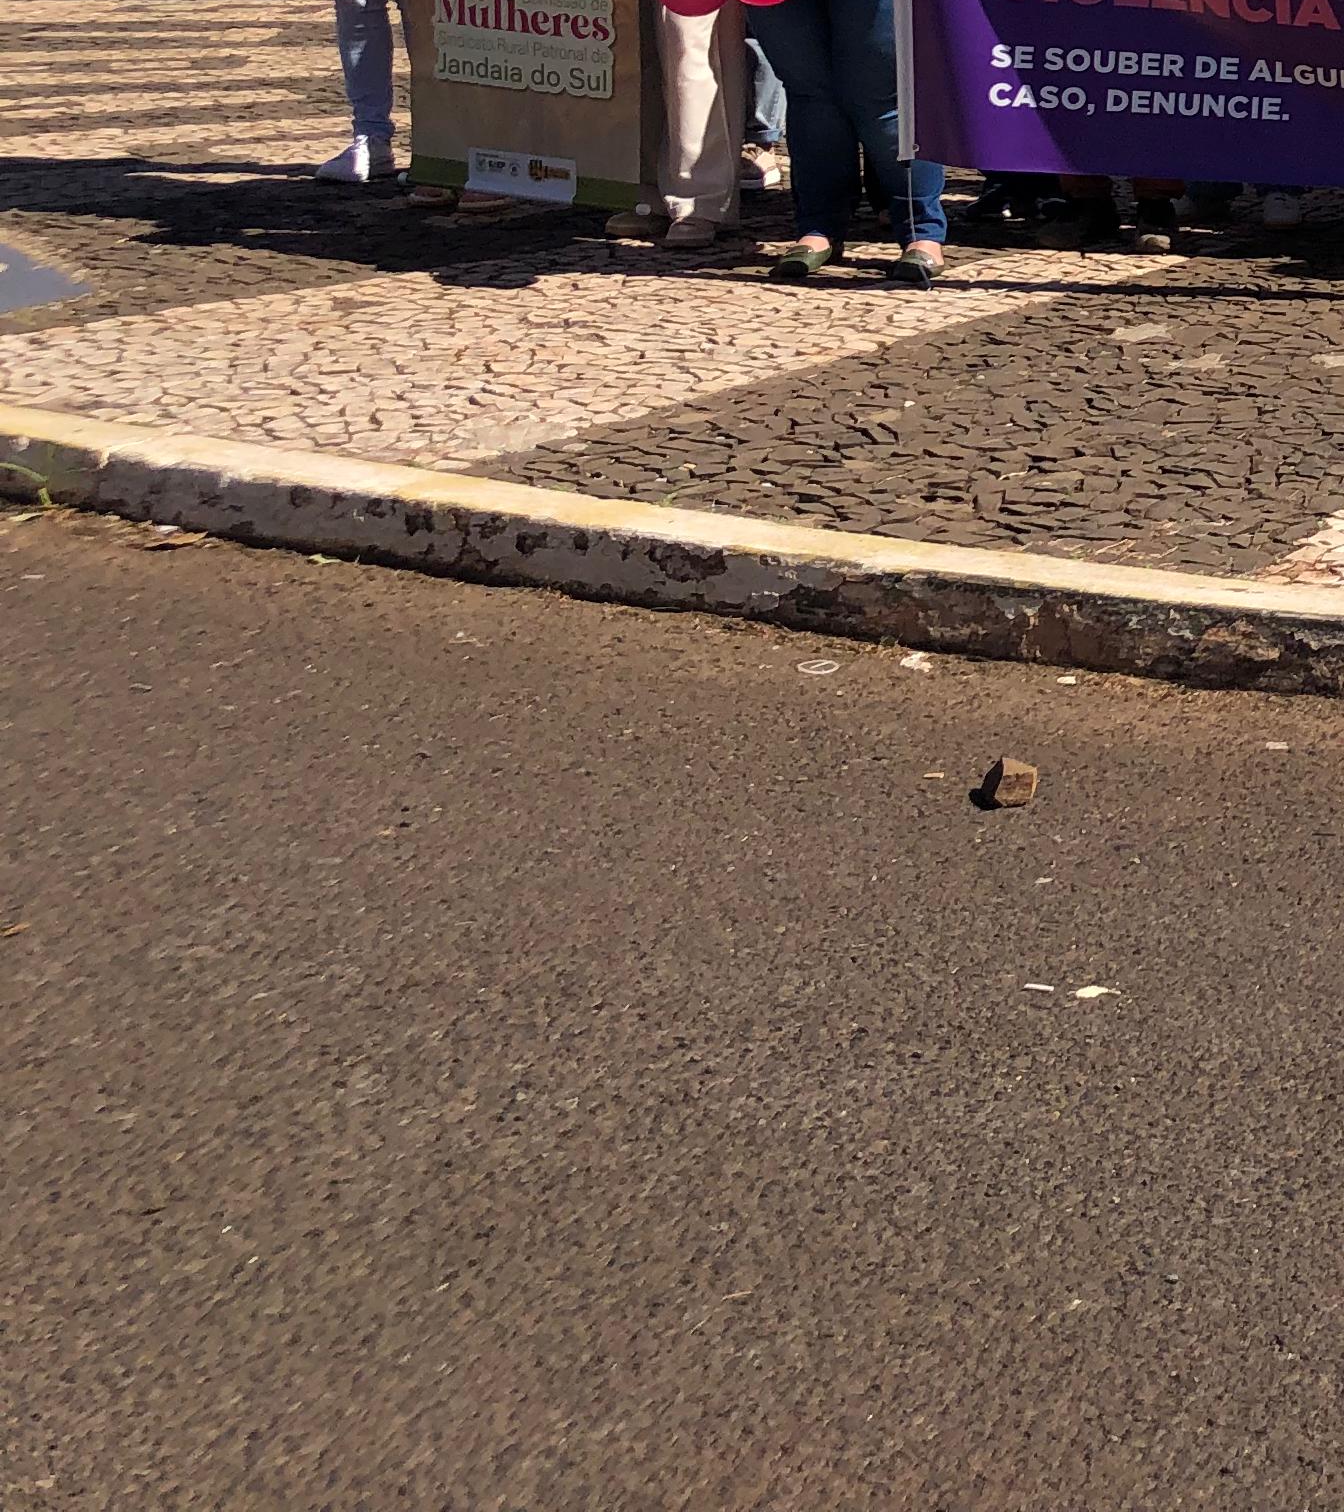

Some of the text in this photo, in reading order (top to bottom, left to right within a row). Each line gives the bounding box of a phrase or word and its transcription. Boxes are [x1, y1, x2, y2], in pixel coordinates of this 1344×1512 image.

[497, 37, 529, 57] Rural
[532, 41, 588, 63] Patronal
[990, 43, 1035, 70] SE
[1044, 47, 1183, 79] SOUBER
[1195, 55, 1242, 82] DE
[438, 52, 608, 93] Jandaia do Sul
[988, 82, 1290, 122] CASO, DENUNCIE.
